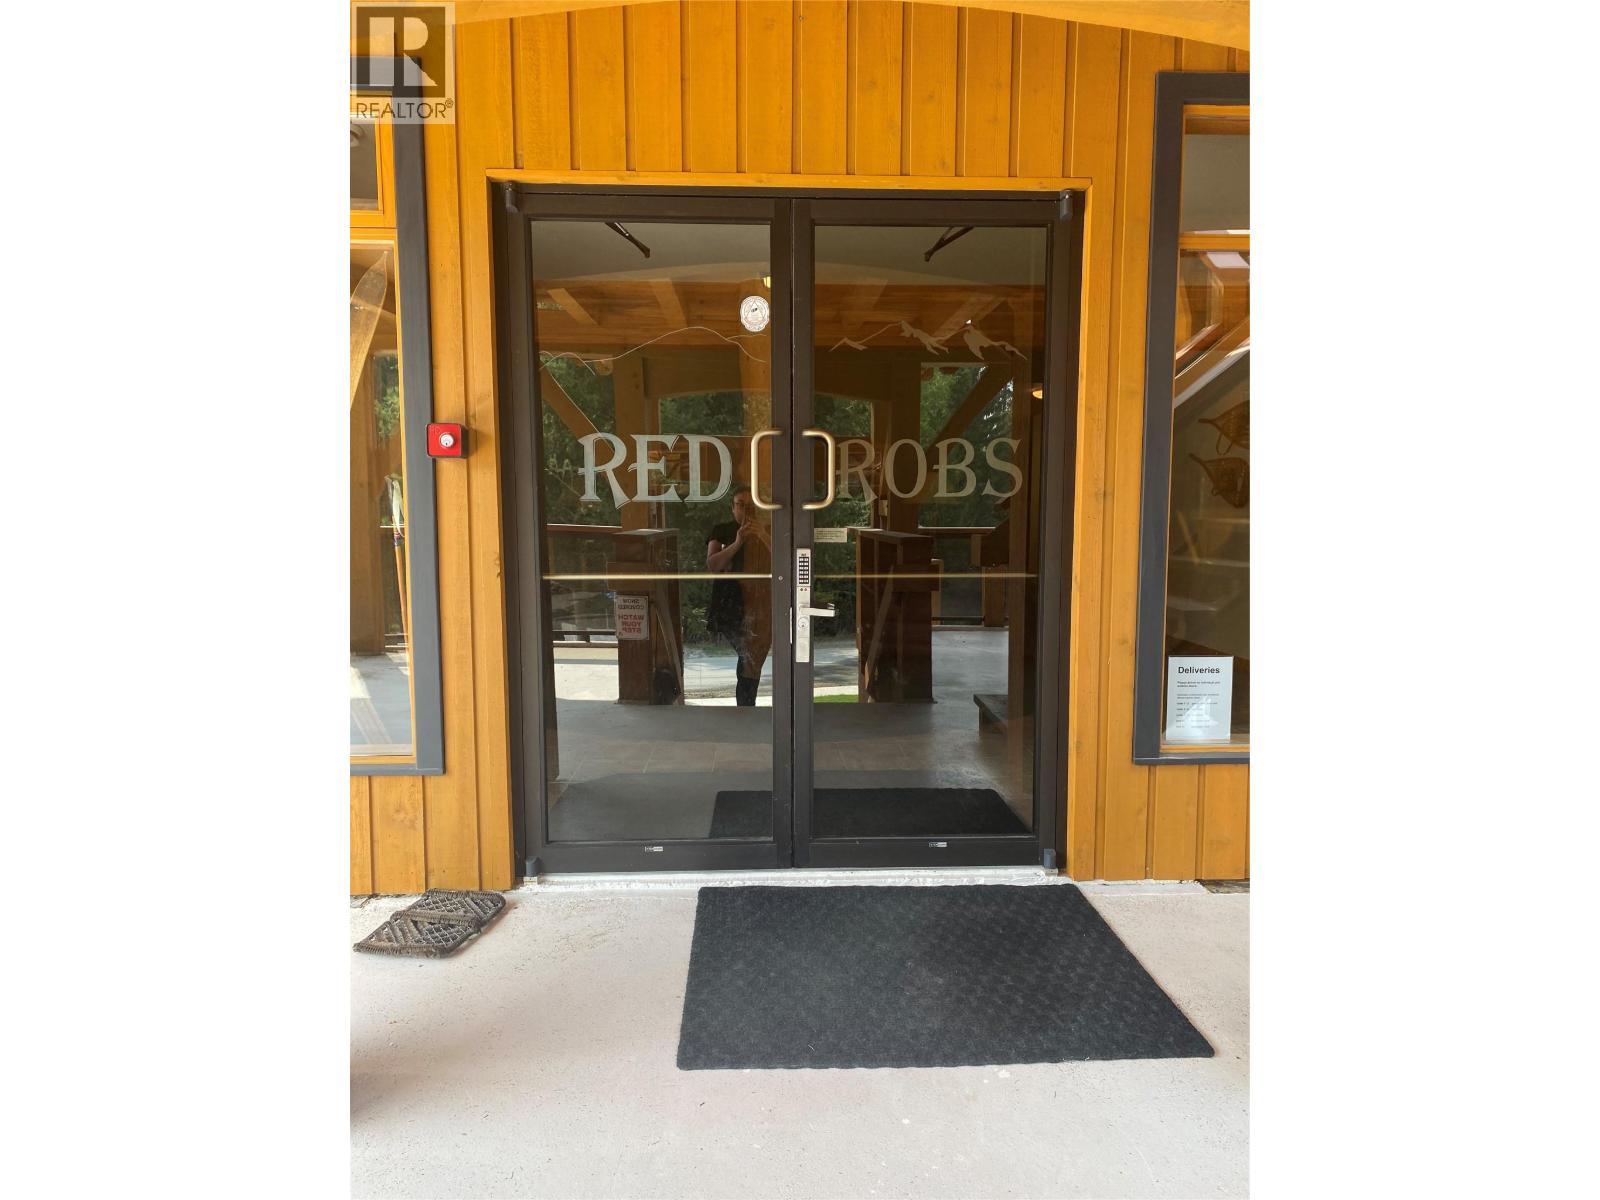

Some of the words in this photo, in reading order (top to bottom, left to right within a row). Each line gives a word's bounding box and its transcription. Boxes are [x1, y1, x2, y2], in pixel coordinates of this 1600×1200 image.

[577, 433, 734, 509] RED
[835, 437, 1024, 505] ROBS
[1178, 666, 1220, 674] Deliveries
